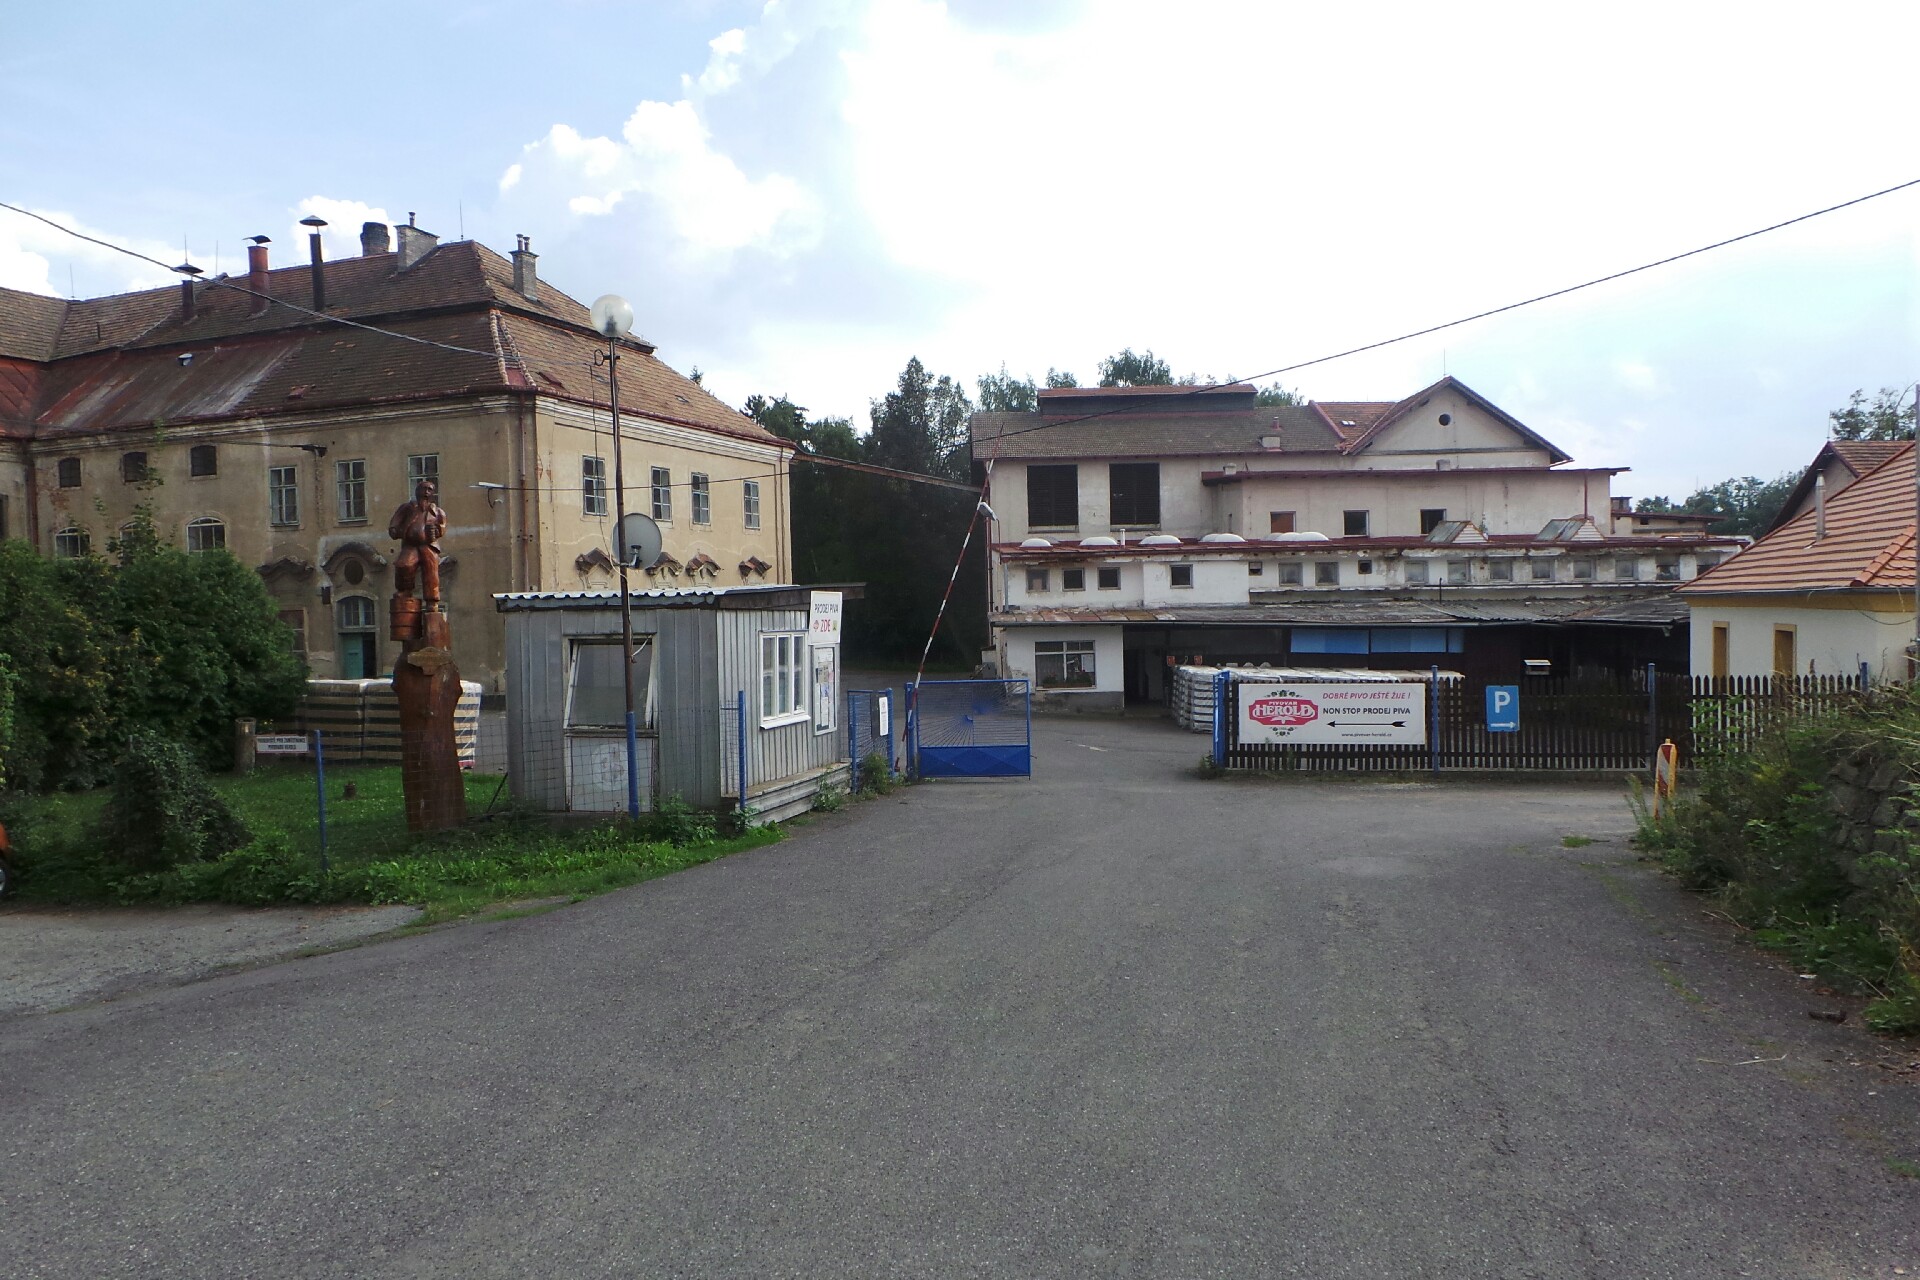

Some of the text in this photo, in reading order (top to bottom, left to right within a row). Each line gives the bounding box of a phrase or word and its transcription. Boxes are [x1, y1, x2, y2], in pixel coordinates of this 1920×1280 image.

[820, 619, 831, 632] ZDE
[1322, 691, 1349, 699] DOBRÉ
[1391, 691, 1406, 699] ŽIJE
[1494, 691, 1511, 714] P
[1253, 704, 1315, 718] HEROLD
